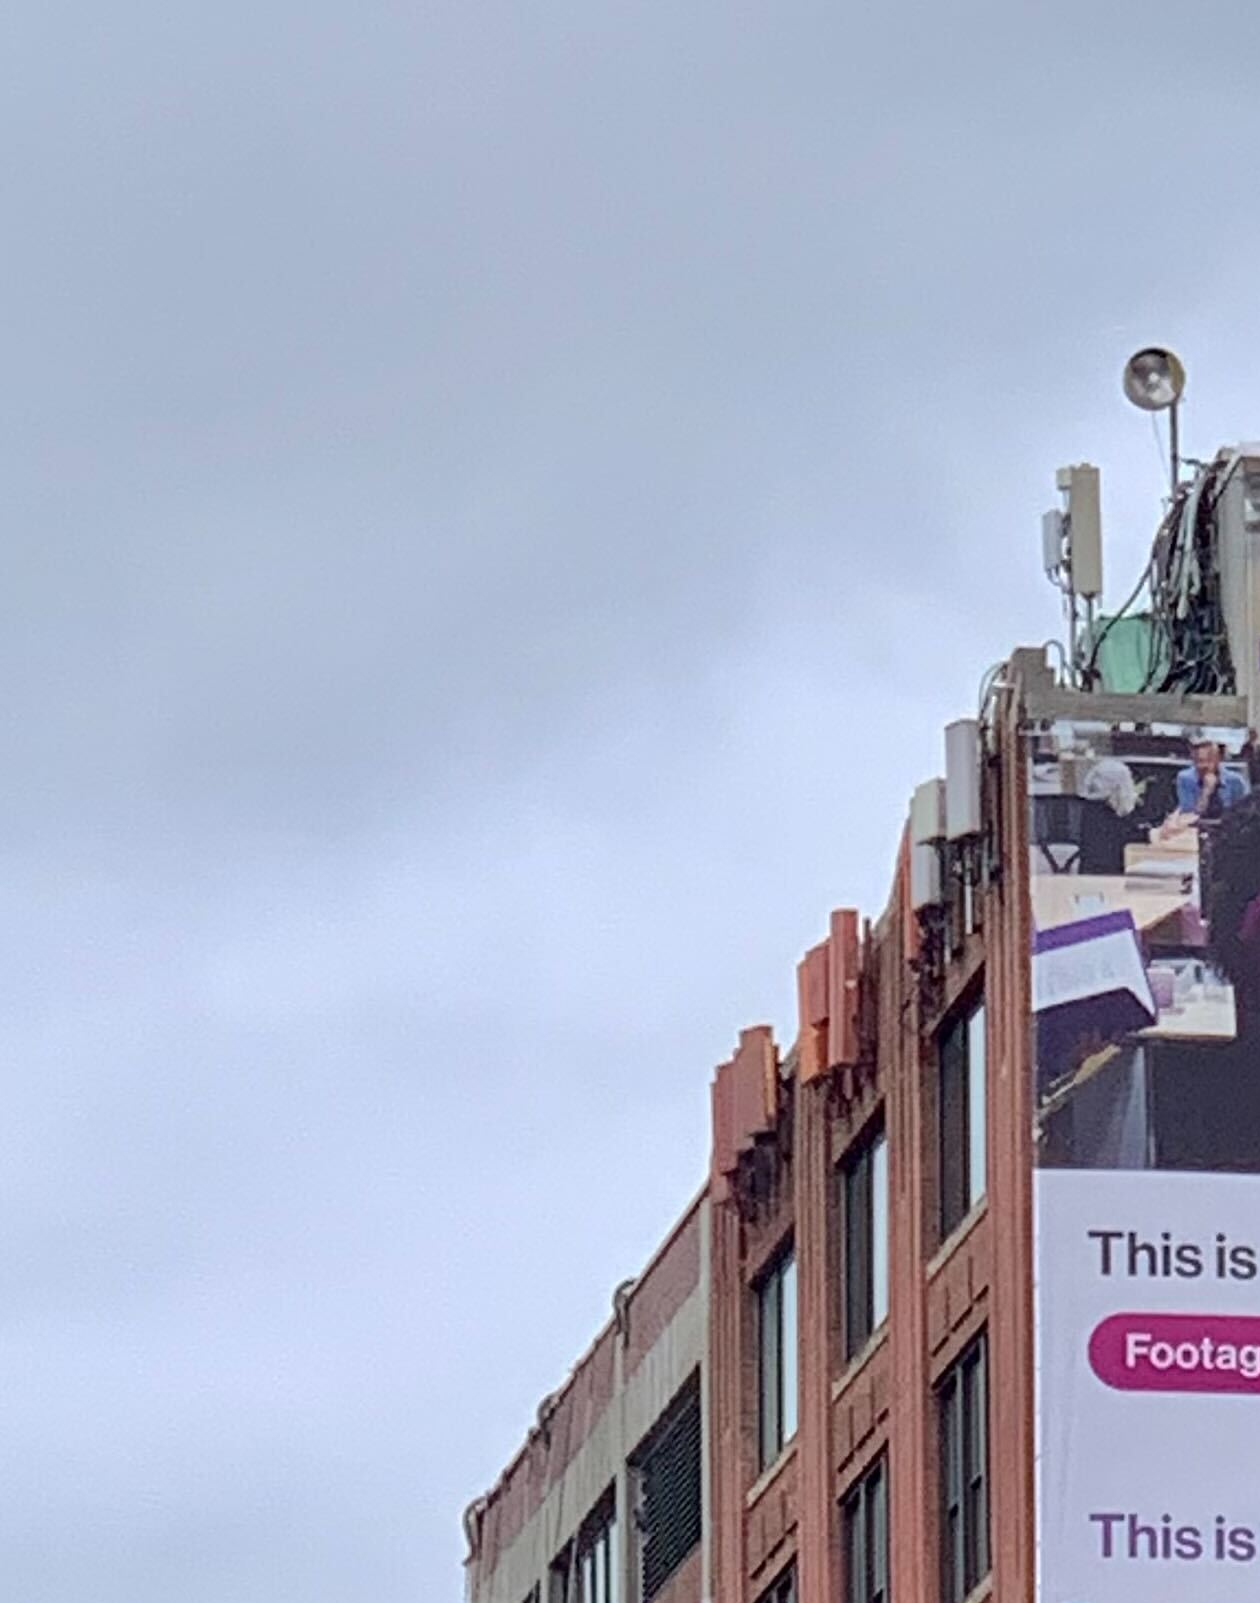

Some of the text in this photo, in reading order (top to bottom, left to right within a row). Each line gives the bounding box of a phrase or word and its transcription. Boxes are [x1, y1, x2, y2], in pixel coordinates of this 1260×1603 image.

[1087, 1230, 1203, 1279] This
[1215, 1232, 1258, 1280] is
[1089, 1513, 1203, 1560] This
[1215, 1515, 1257, 1562] is
